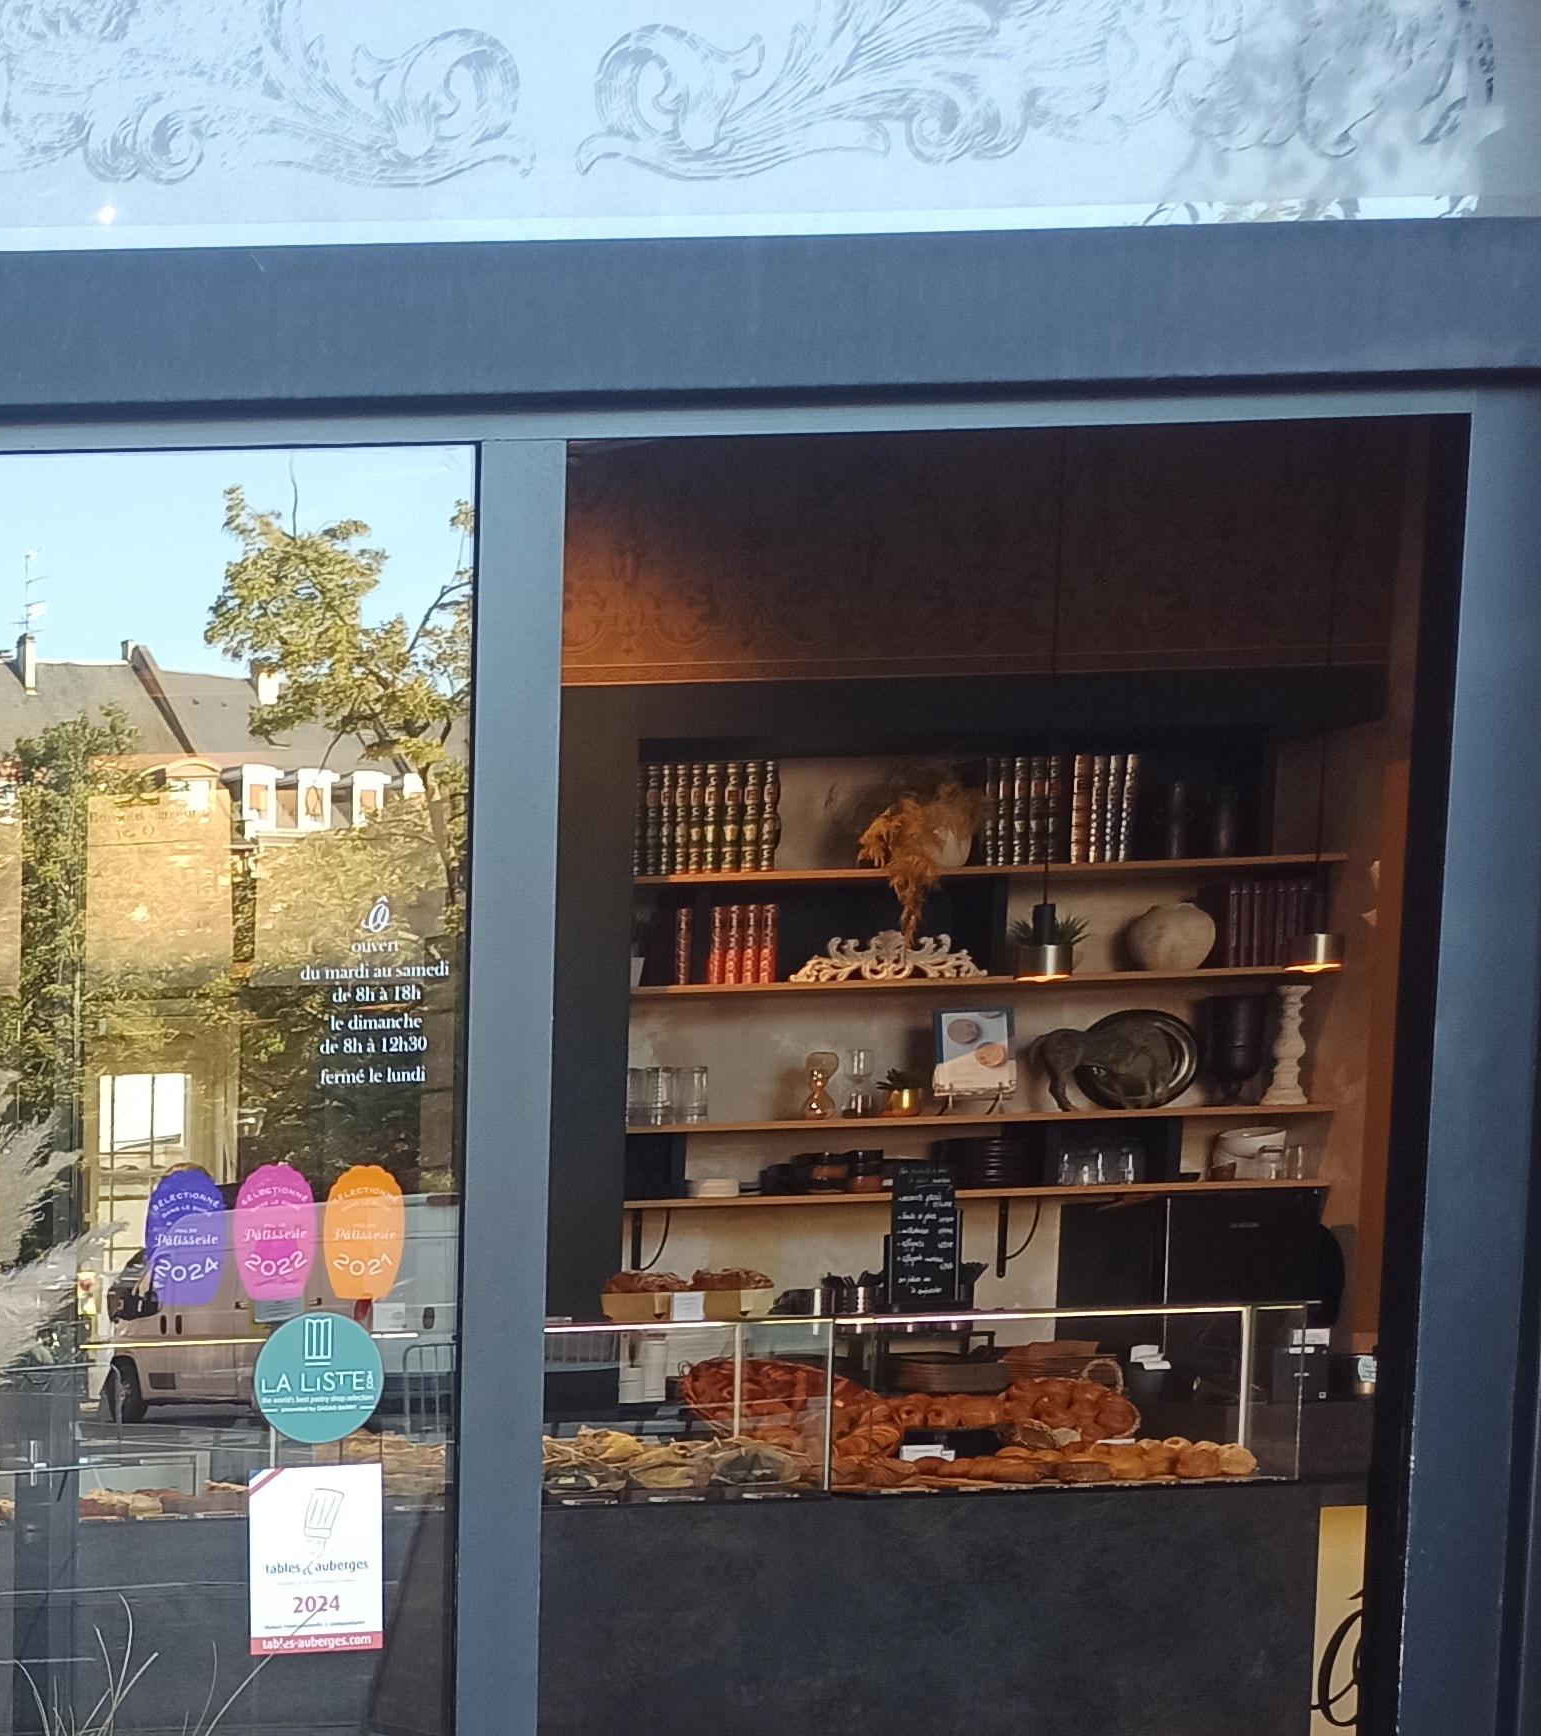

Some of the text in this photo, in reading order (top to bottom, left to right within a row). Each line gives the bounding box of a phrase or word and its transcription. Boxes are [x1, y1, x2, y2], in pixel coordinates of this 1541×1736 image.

[351, 940, 399, 953] ouvert
[300, 960, 450, 981] du mardi au samedi
[332, 984, 421, 1003] de 8h à 18h
[330, 1013, 423, 1031] le dimanche
[319, 1036, 428, 1055] de 8h à 12h30
[320, 1065, 426, 1085] fermé le lundi
[154, 1257, 219, 1281] 2024
[244, 1250, 308, 1276] 2022
[332, 1253, 394, 1276] 2021
[261, 1373, 292, 1393] LA
[265, 1561, 301, 1575] tables
[314, 1559, 369, 1573] auberges
[293, 1594, 341, 1614] 2024
[262, 1634, 372, 1650] tables-auberges.com
